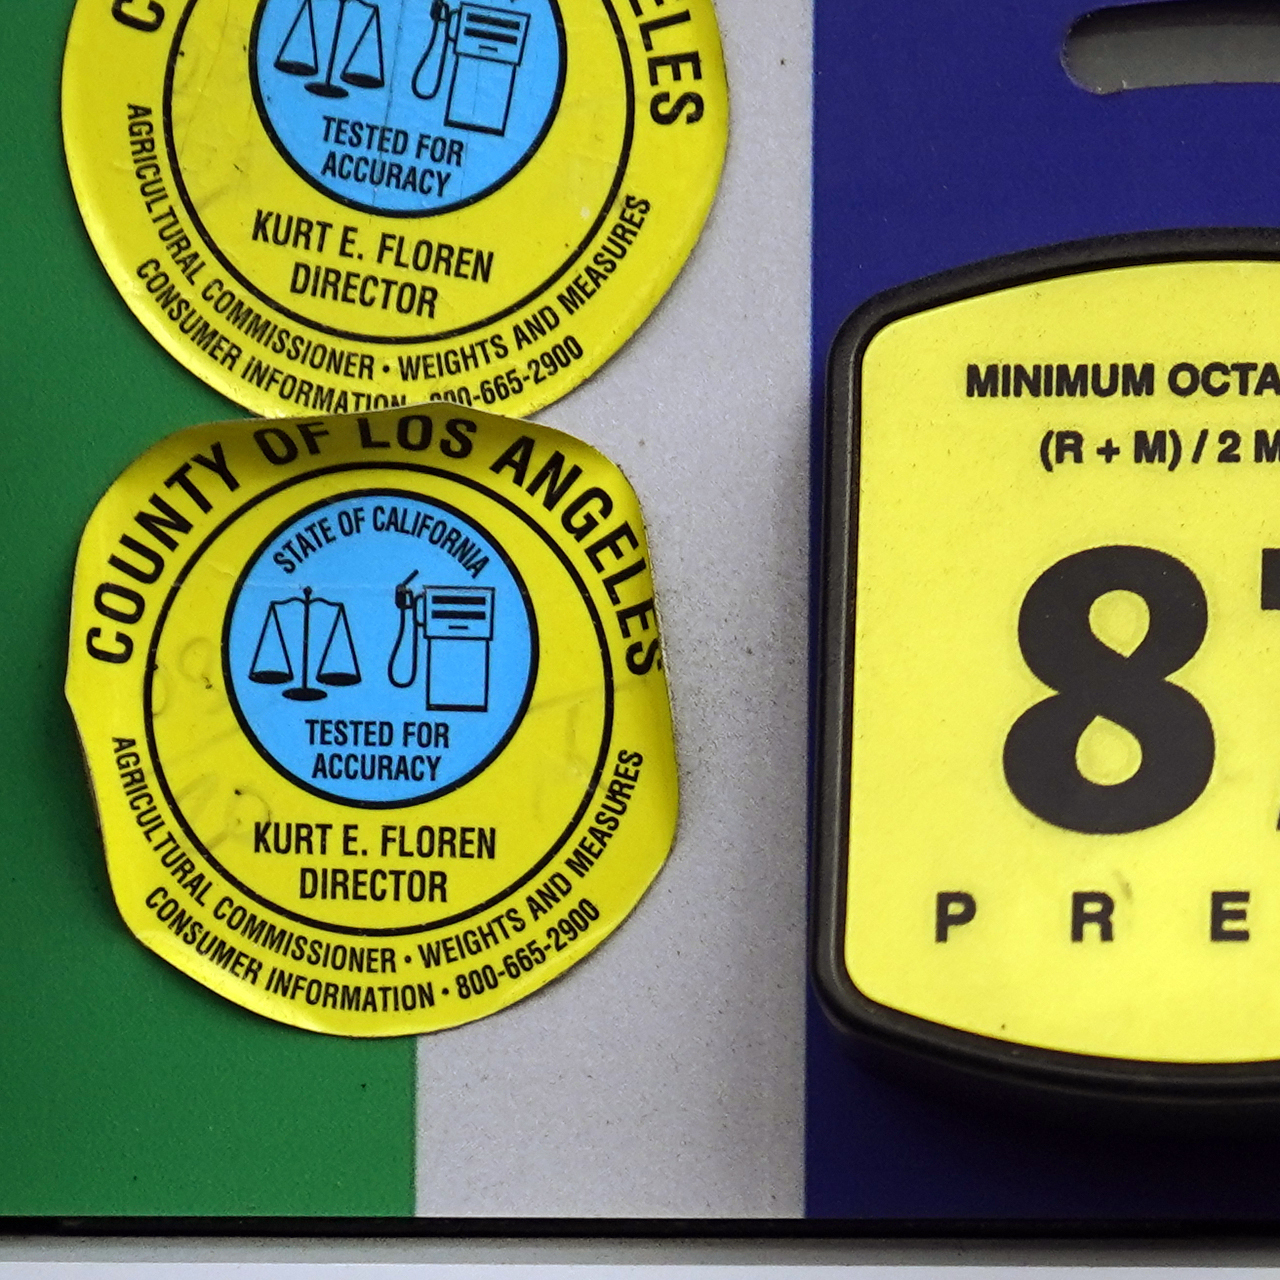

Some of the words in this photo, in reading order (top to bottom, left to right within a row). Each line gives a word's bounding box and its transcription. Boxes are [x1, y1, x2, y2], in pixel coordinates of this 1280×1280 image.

[322, 116, 410, 156] TESTED
[416, 136, 464, 168] FOR
[321, 150, 451, 199] ACCURACY
[126, 103, 205, 285] AGRICULTURAL
[201, 281, 376, 382] COMMISSIONER
[398, 334, 509, 383] WEIGHTS
[514, 302, 561, 353] AND
[557, 193, 653, 315] MEASURES
[252, 208, 330, 256] KURT
[340, 226, 365, 262] E.
[378, 233, 494, 284] FLOREN
[135, 257, 240, 373] CONSUMER
[290, 263, 439, 319] DIRECTOR
[965, 364, 1155, 397] MINIMUM
[1039, 431, 1084, 470] (R
[1133, 430, 1183, 468] M)
[1218, 432, 1242, 463] 2
[86, 442, 243, 665] COUNTY
[261, 422, 331, 468] OF
[361, 413, 479, 460] LOS
[490, 435, 663, 677] ANGELES
[273, 515, 338, 576] STATE
[337, 508, 366, 539] OF
[372, 506, 492, 580] CALIFORNIA
[304, 718, 395, 747] TESTED
[403, 721, 451, 748] FOR
[311, 753, 443, 783] ACCURACY
[110, 735, 212, 908] AGRICULTURAL
[213, 893, 397, 974] COMMISSIONER
[418, 908, 527, 969] WEIGHTS
[527, 880, 572, 932] AND
[569, 748, 646, 889] MEASURES
[253, 822, 331, 857] KURT
[344, 824, 369, 859] E.
[380, 825, 496, 860] FLOREN
[298, 868, 448, 904] DIRECTOR
[145, 885, 262, 989] CONSUMER
[265, 968, 436, 1012] INFORMATION
[456, 897, 601, 1000] 800-665-2900
